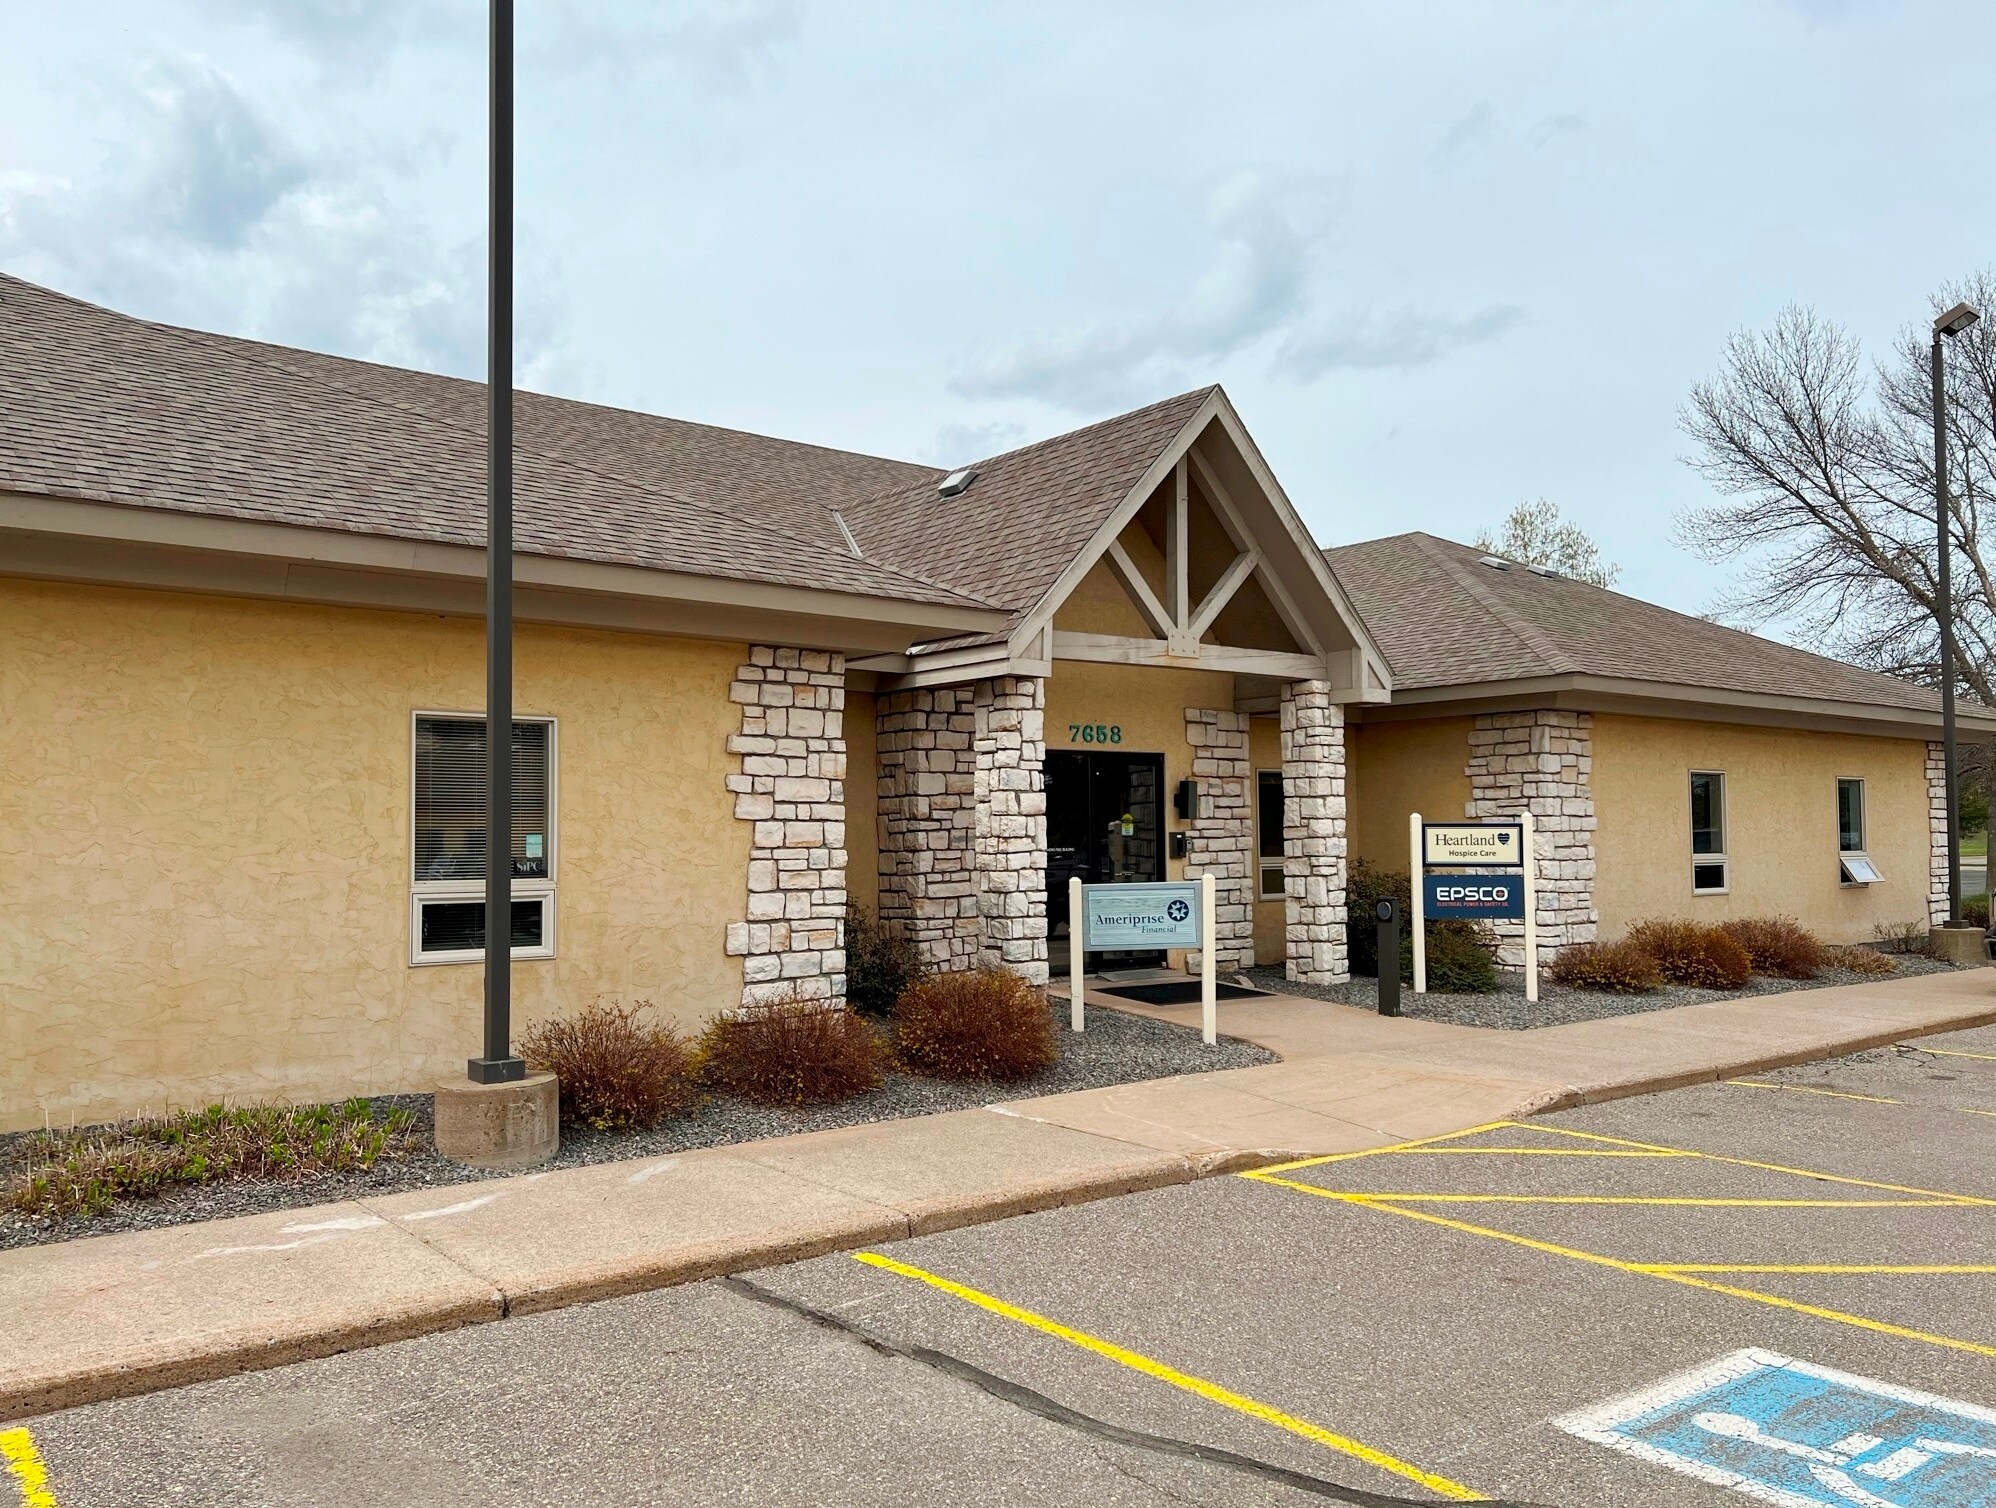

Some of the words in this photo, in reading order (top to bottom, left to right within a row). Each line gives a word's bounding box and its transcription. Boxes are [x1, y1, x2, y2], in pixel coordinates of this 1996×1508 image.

[1068, 725, 1122, 744] 7658
[1435, 833, 1495, 846] Heartland
[1436, 887, 1508, 901] EPSCO
[1095, 913, 1165, 927] Ameriprise
[1141, 924, 1177, 934] Financial
